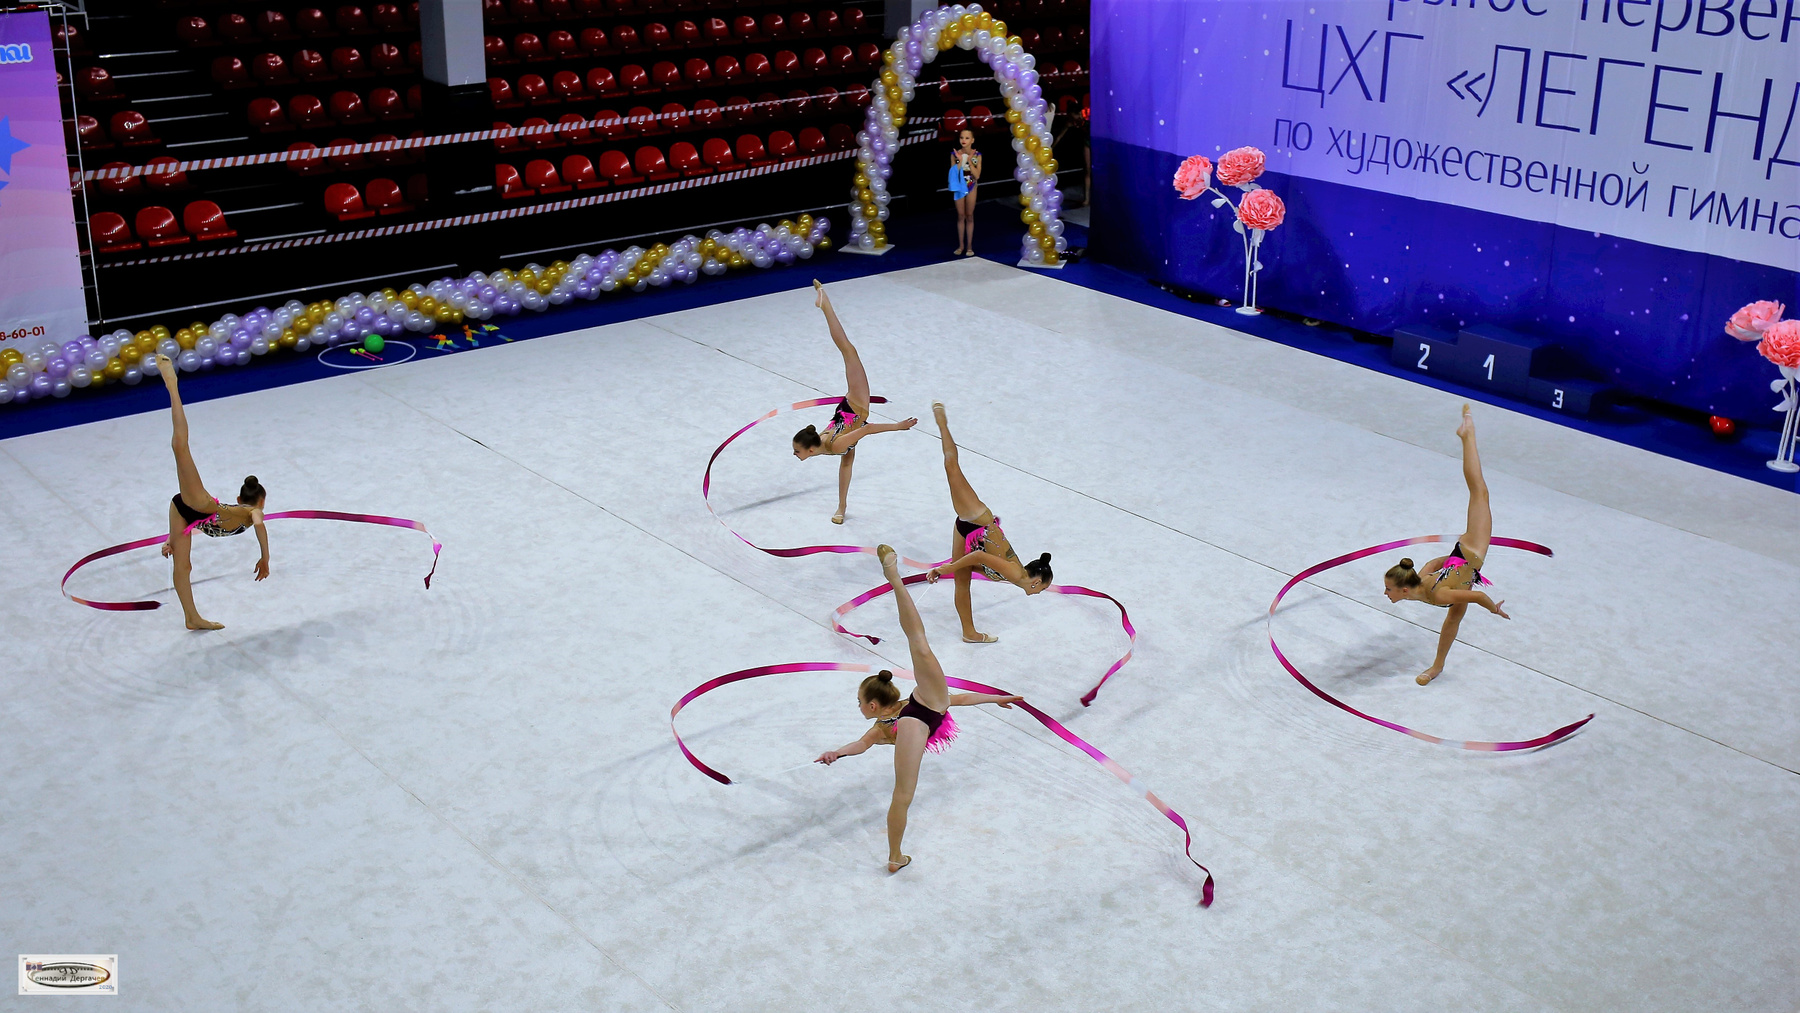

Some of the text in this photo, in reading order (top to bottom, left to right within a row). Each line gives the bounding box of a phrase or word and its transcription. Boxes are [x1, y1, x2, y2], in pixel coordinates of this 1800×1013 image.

[1282, 19, 1424, 109] ЦХГ
[1273, 118, 1800, 240] по художественной гимна
[0, 326, 45, 341] 8-60-01
[1417, 343, 1431, 370] 2
[1483, 354, 1495, 380] 1
[1552, 388, 1564, 408] 3
